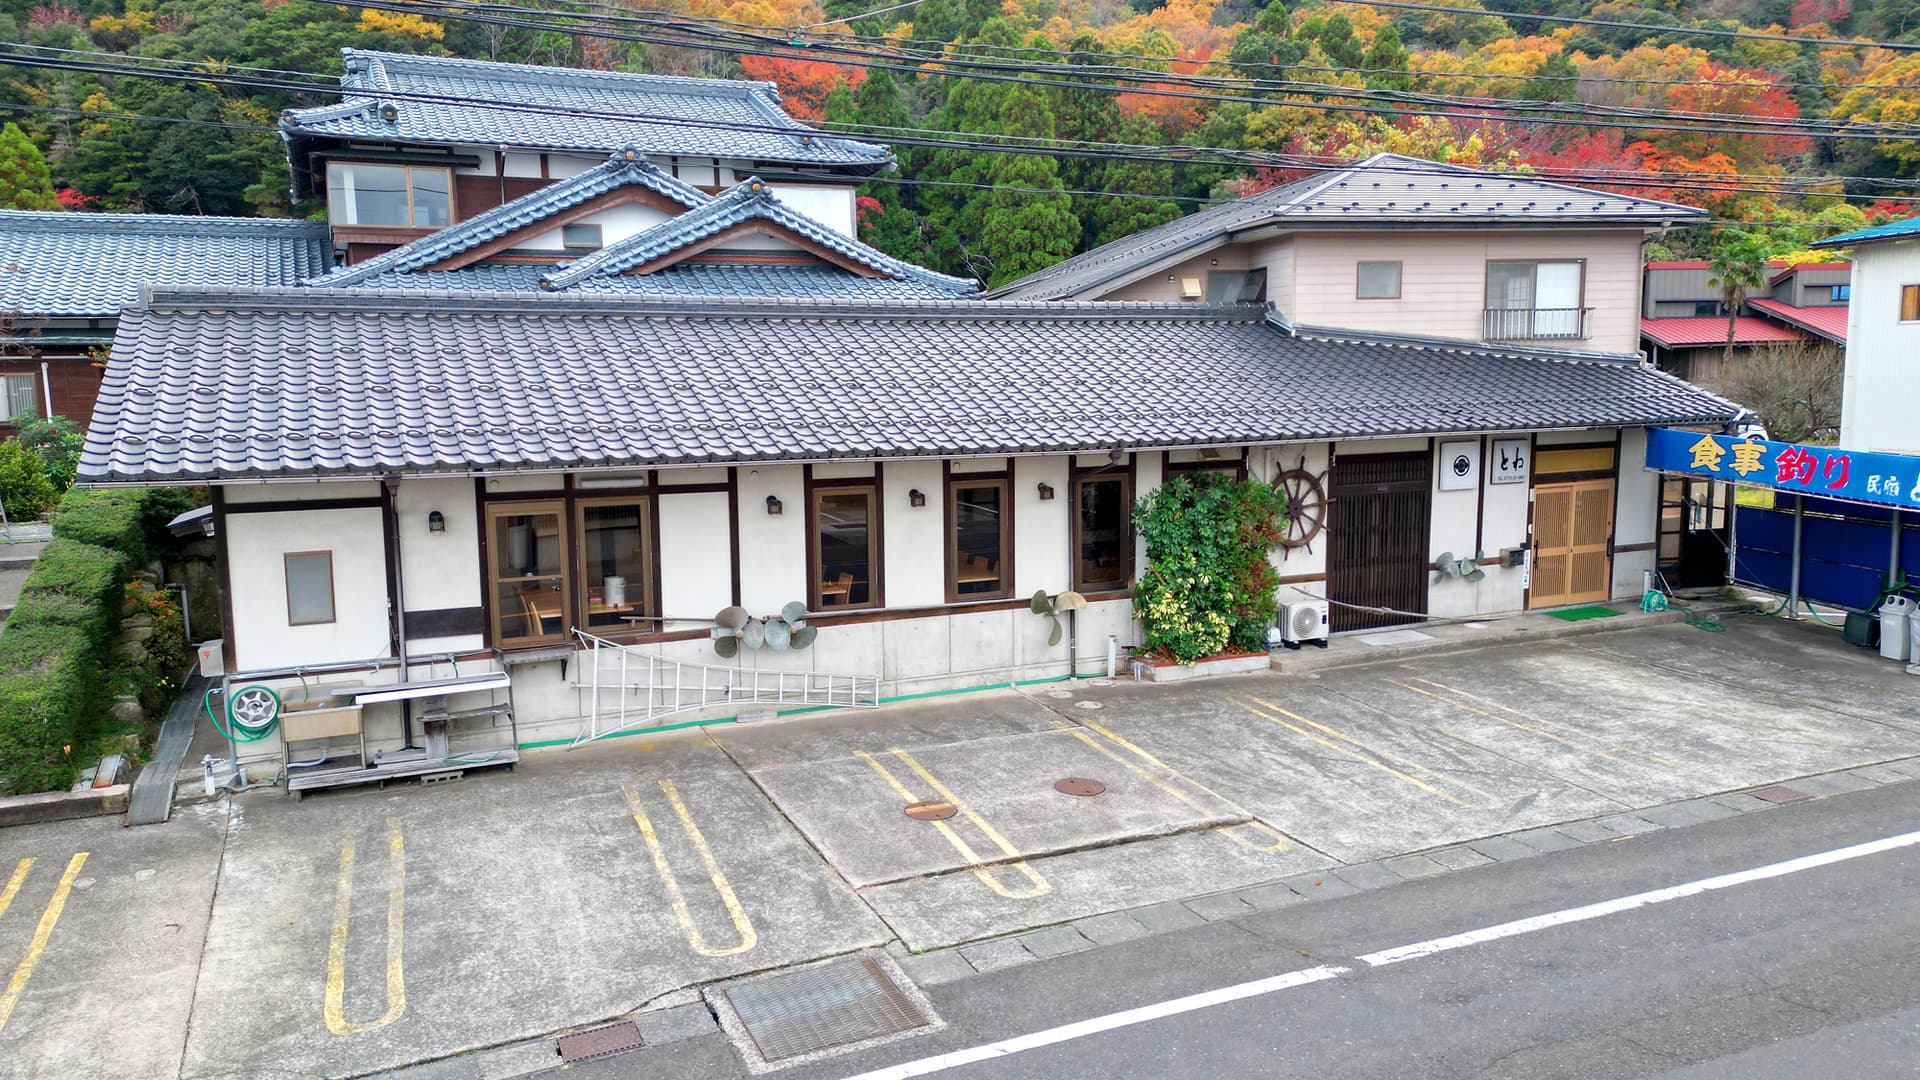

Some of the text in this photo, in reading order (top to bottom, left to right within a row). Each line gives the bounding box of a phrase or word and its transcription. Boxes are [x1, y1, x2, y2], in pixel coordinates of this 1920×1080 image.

[1689, 434, 1767, 477] 食事
[1775, 445, 1852, 489] 釣り
[1867, 474, 1900, 497] 民宿
